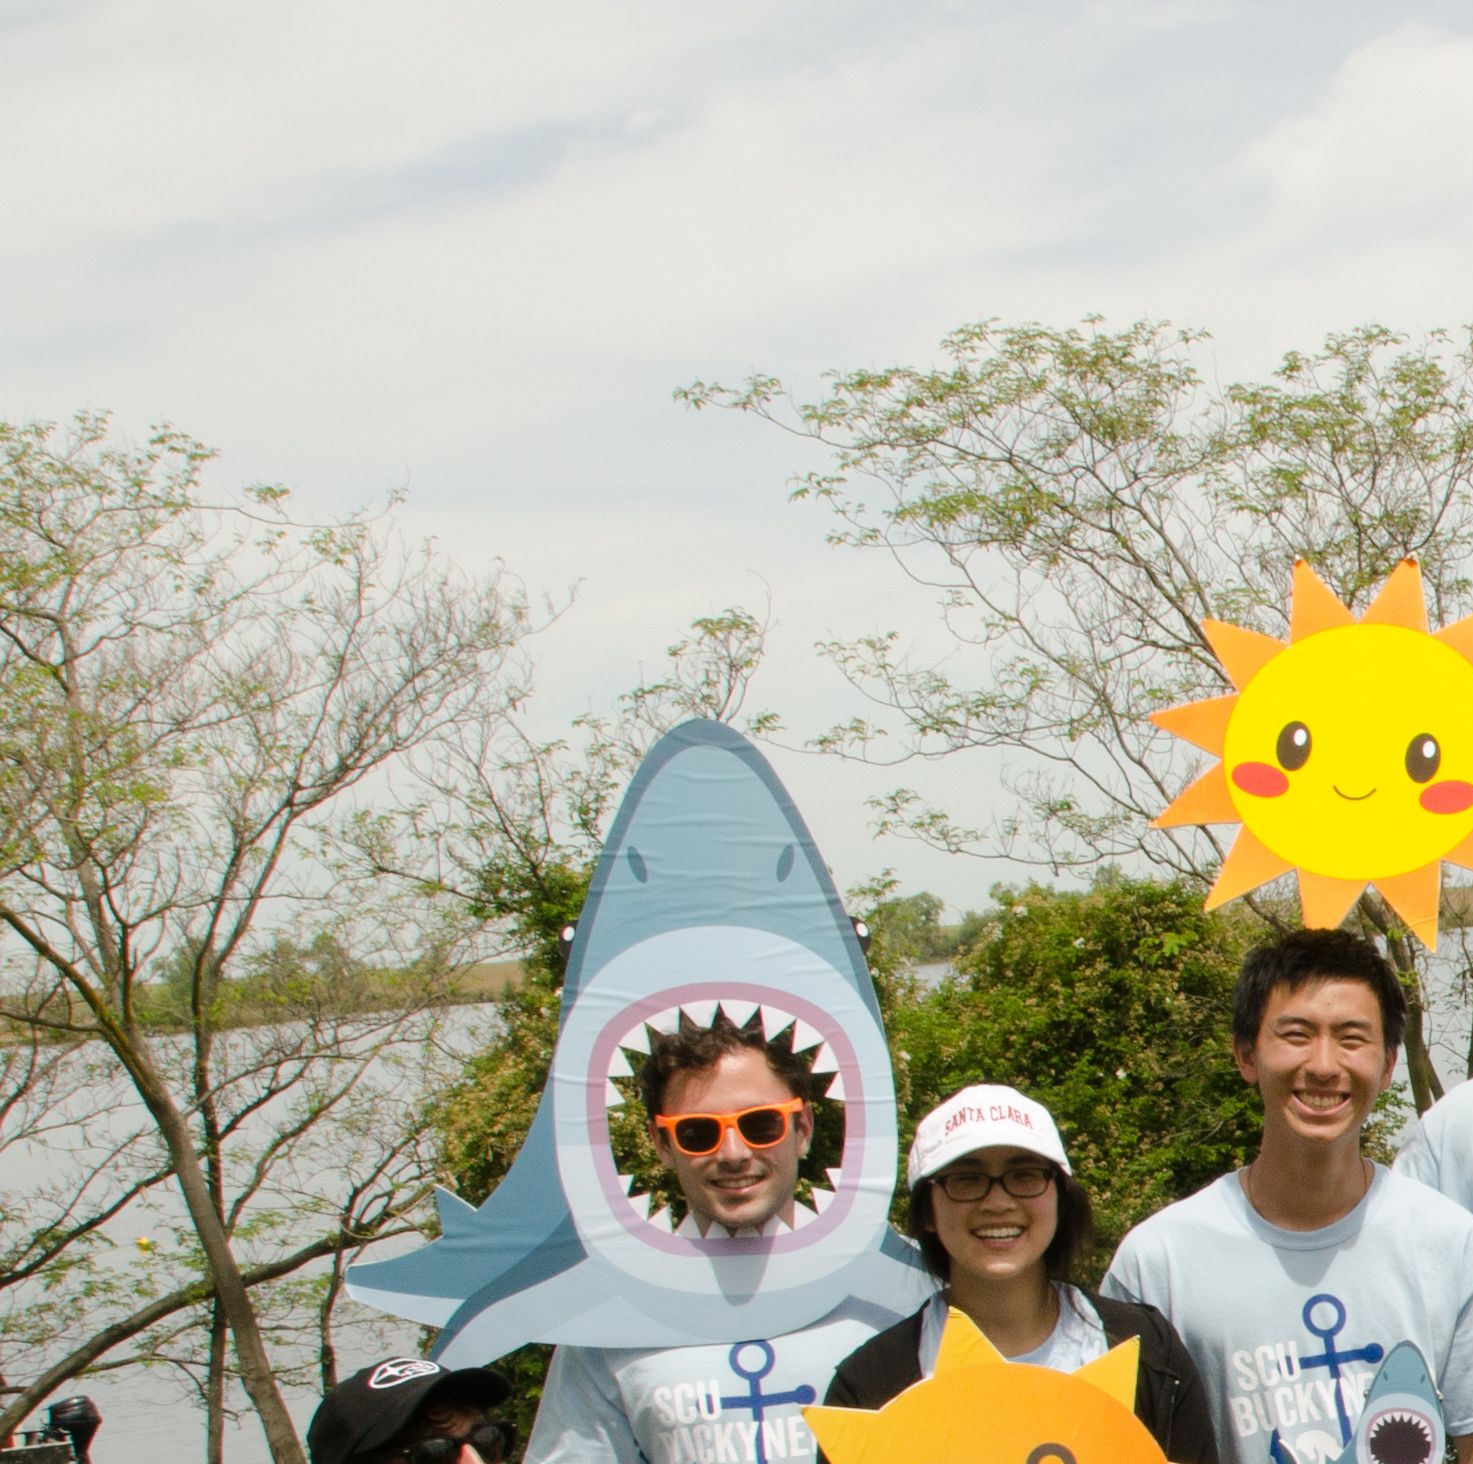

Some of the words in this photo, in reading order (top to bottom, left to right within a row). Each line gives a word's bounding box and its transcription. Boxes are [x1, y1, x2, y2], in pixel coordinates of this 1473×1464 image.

[945, 1106, 985, 1137] SANTA
[989, 1105, 1034, 1131] CLARA
[1231, 1340, 1301, 1392] SCU
[653, 1379, 722, 1428] SCU
